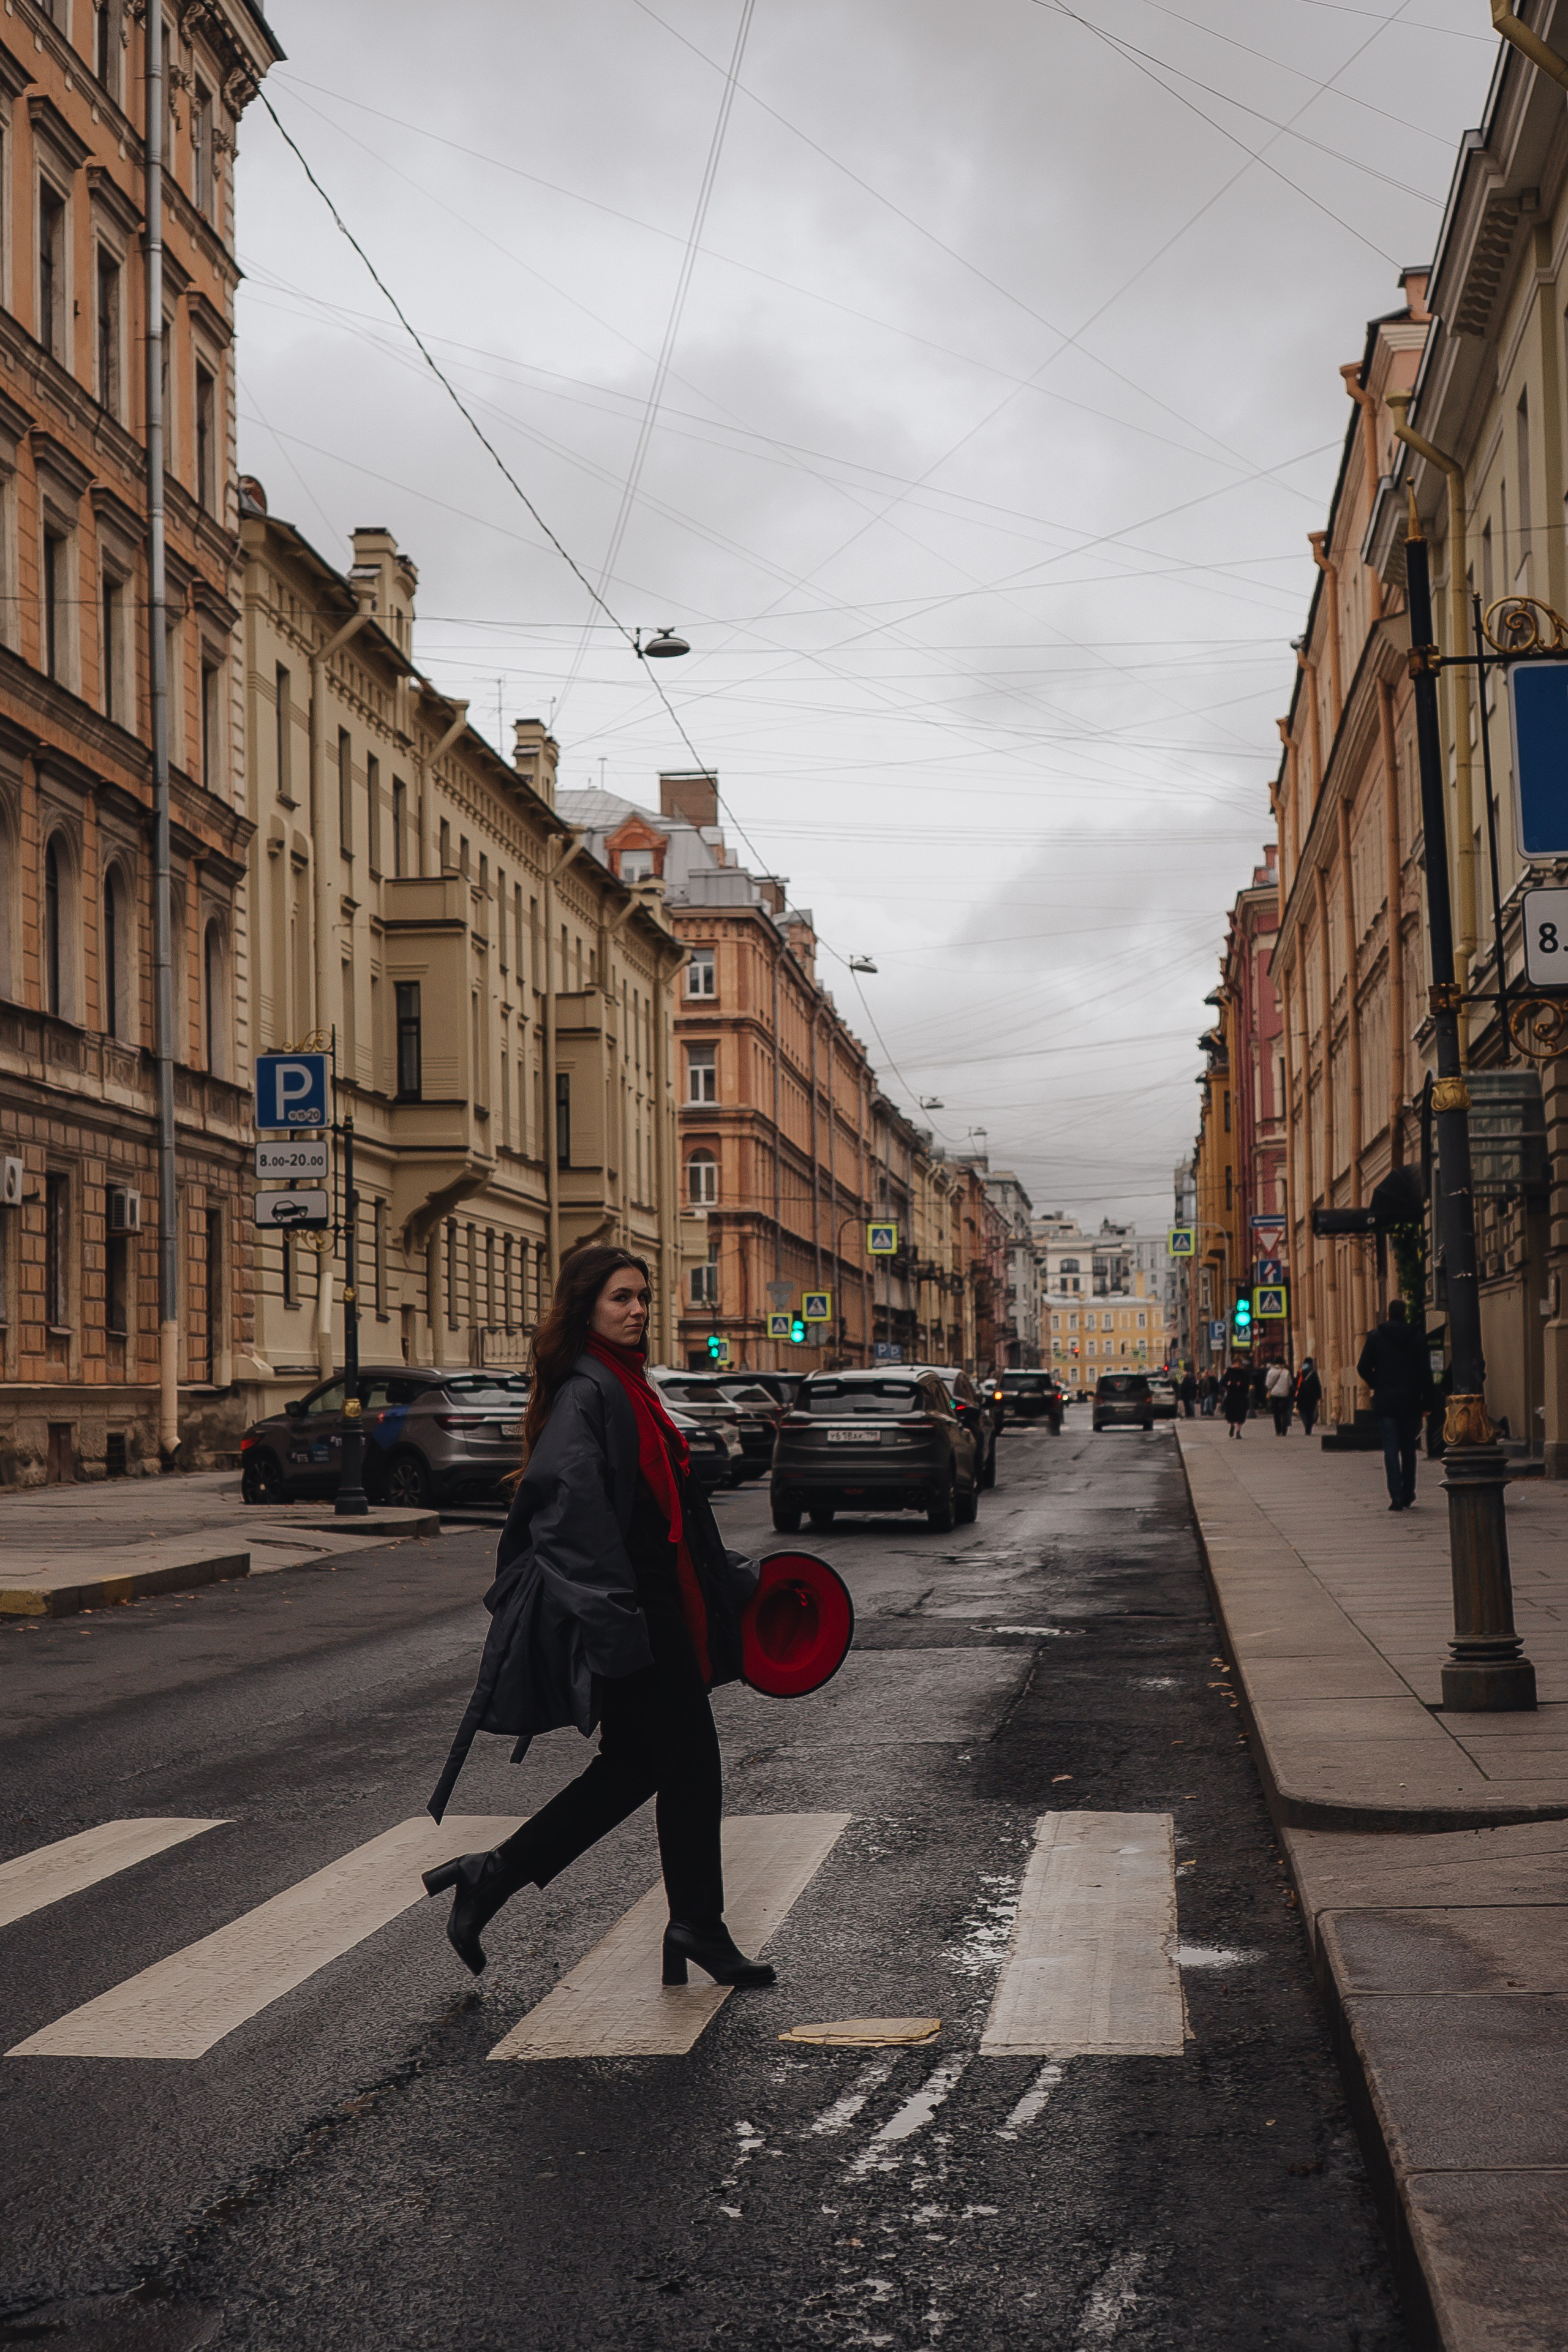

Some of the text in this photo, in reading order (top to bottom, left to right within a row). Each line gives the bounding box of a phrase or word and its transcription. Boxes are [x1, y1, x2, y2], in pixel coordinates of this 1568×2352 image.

[276, 1063, 312, 1120] P
[307, 1110, 320, 1120] 20
[260, 1153, 324, 1167] 8.00-20.00
